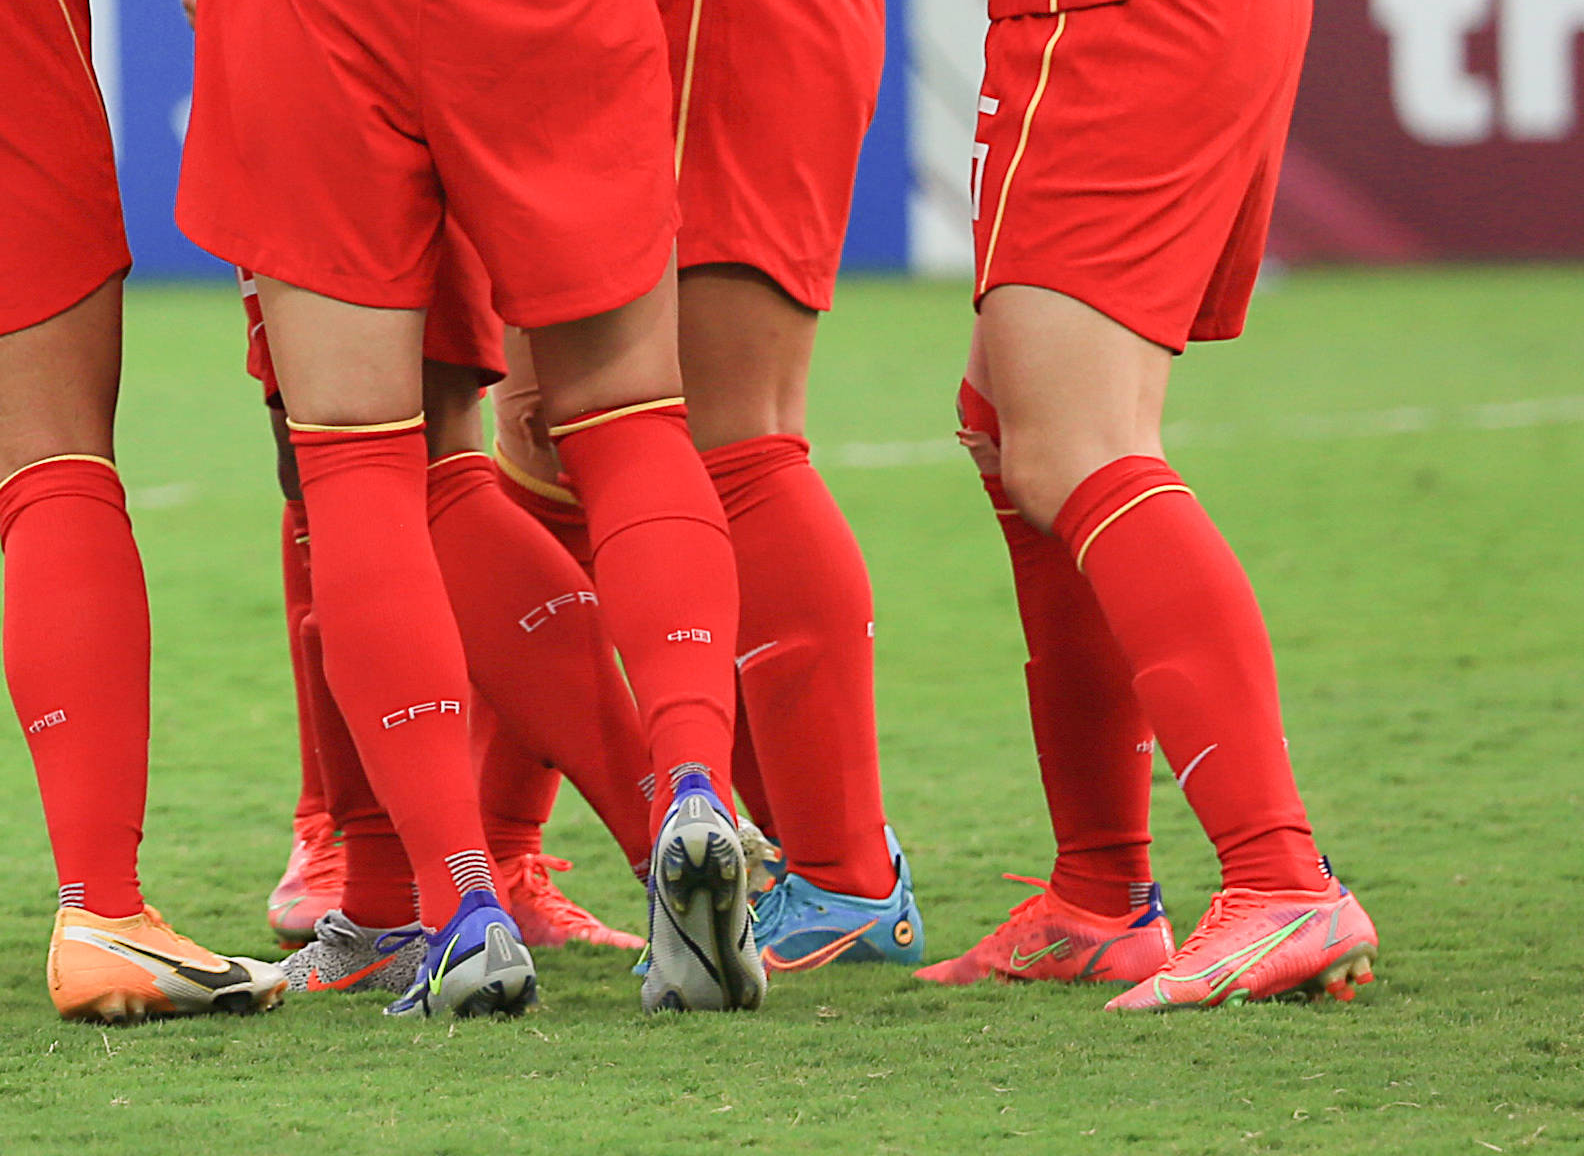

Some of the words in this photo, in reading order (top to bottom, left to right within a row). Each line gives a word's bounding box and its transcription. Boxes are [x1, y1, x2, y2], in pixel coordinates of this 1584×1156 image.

[518, 590, 599, 633] CFA
[667, 628, 711, 643] 中国
[28, 709, 66, 733] 中国
[382, 699, 460, 729] CFA
